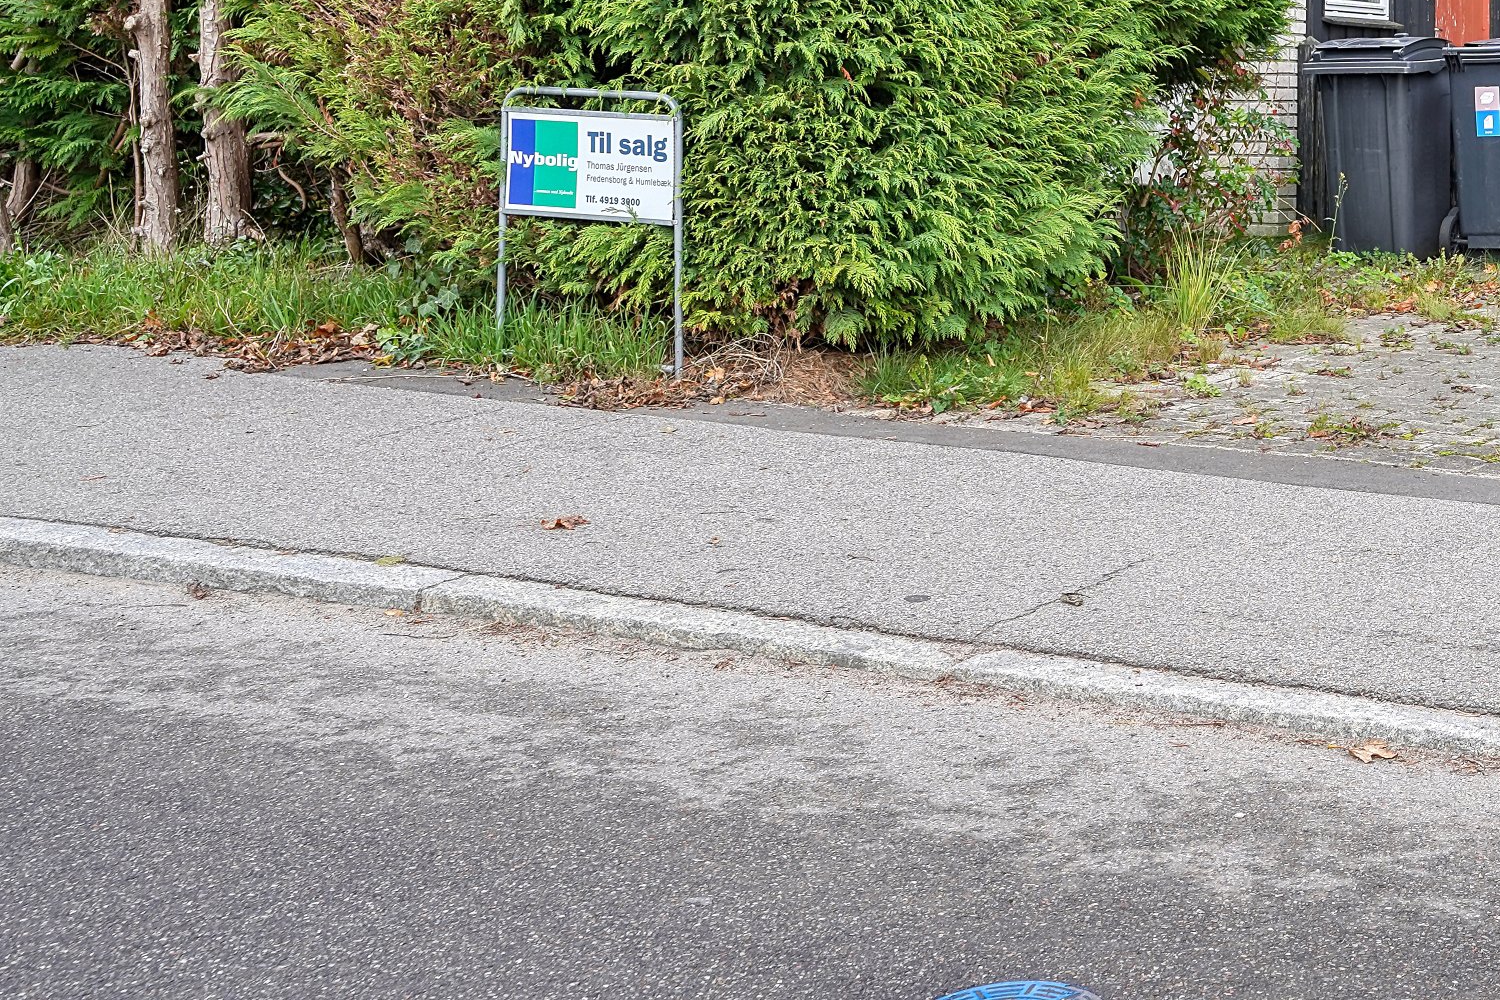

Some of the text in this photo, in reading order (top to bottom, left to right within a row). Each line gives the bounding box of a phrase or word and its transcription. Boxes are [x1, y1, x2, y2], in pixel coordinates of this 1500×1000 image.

[587, 131, 668, 162] Til salg
[510, 150, 578, 172] Nybolig
[587, 160, 615, 171] Thomas
[586, 174, 672, 188] Fredensborg & Humlebæk
[586, 195, 641, 207] Tlf. 4919 3000
